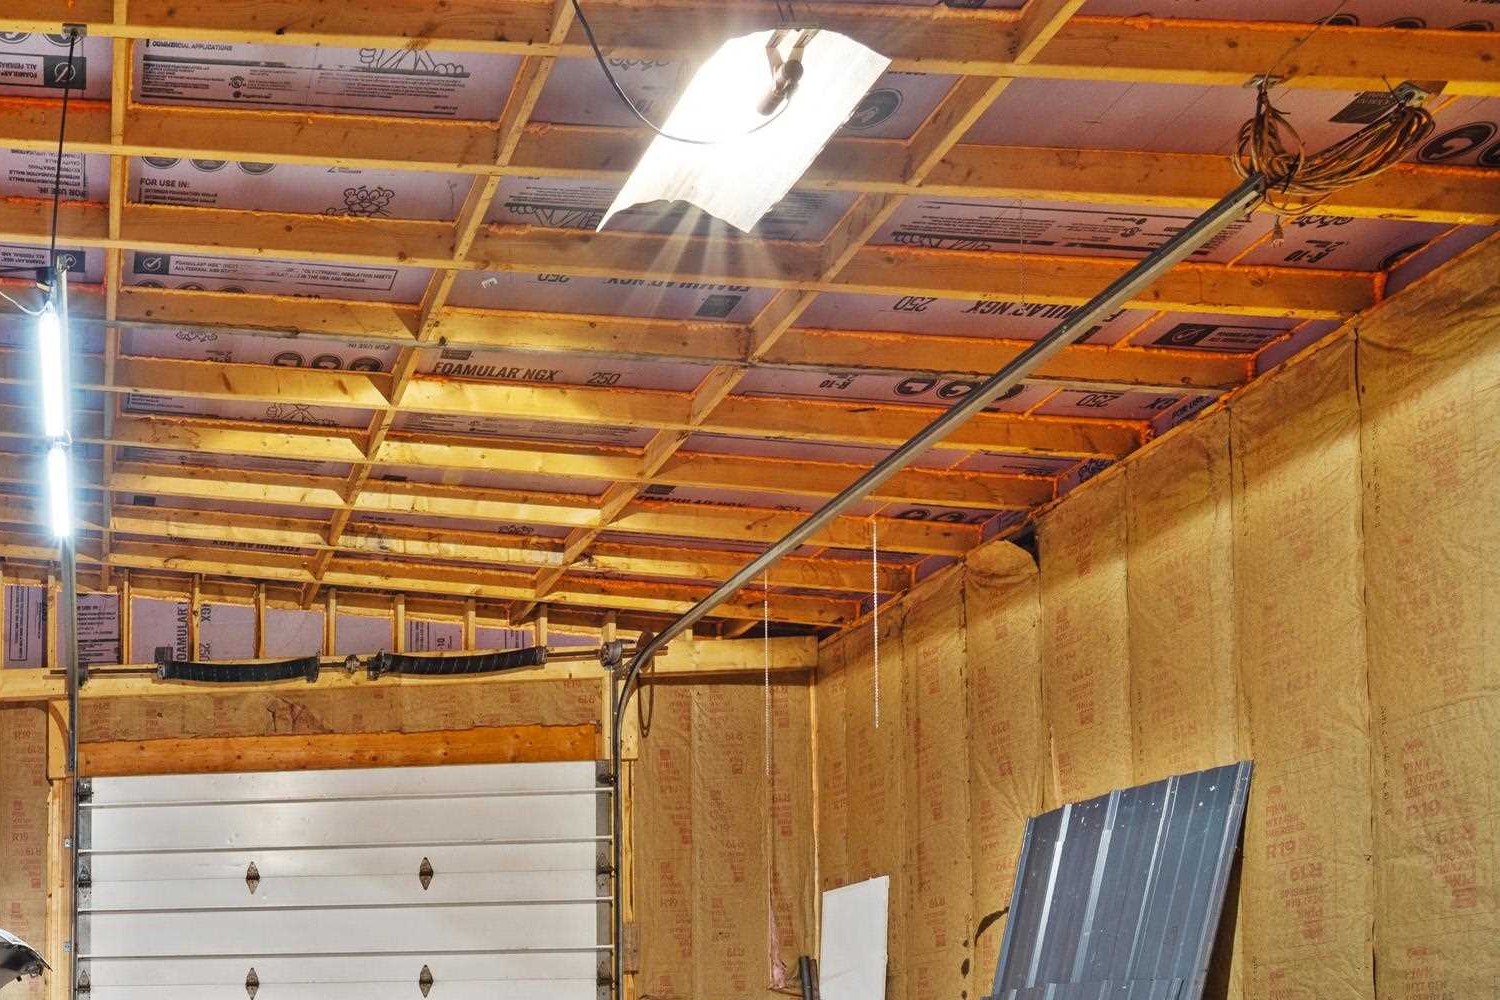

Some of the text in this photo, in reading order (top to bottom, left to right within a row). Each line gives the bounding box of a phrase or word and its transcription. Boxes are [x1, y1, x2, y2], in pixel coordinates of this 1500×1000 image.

[140, 178, 157, 186] FOR
[159, 179, 175, 187] USE
[893, 295, 938, 313] 250
[586, 372, 620, 386] 250
[176, 608, 189, 664] OAMULAR
